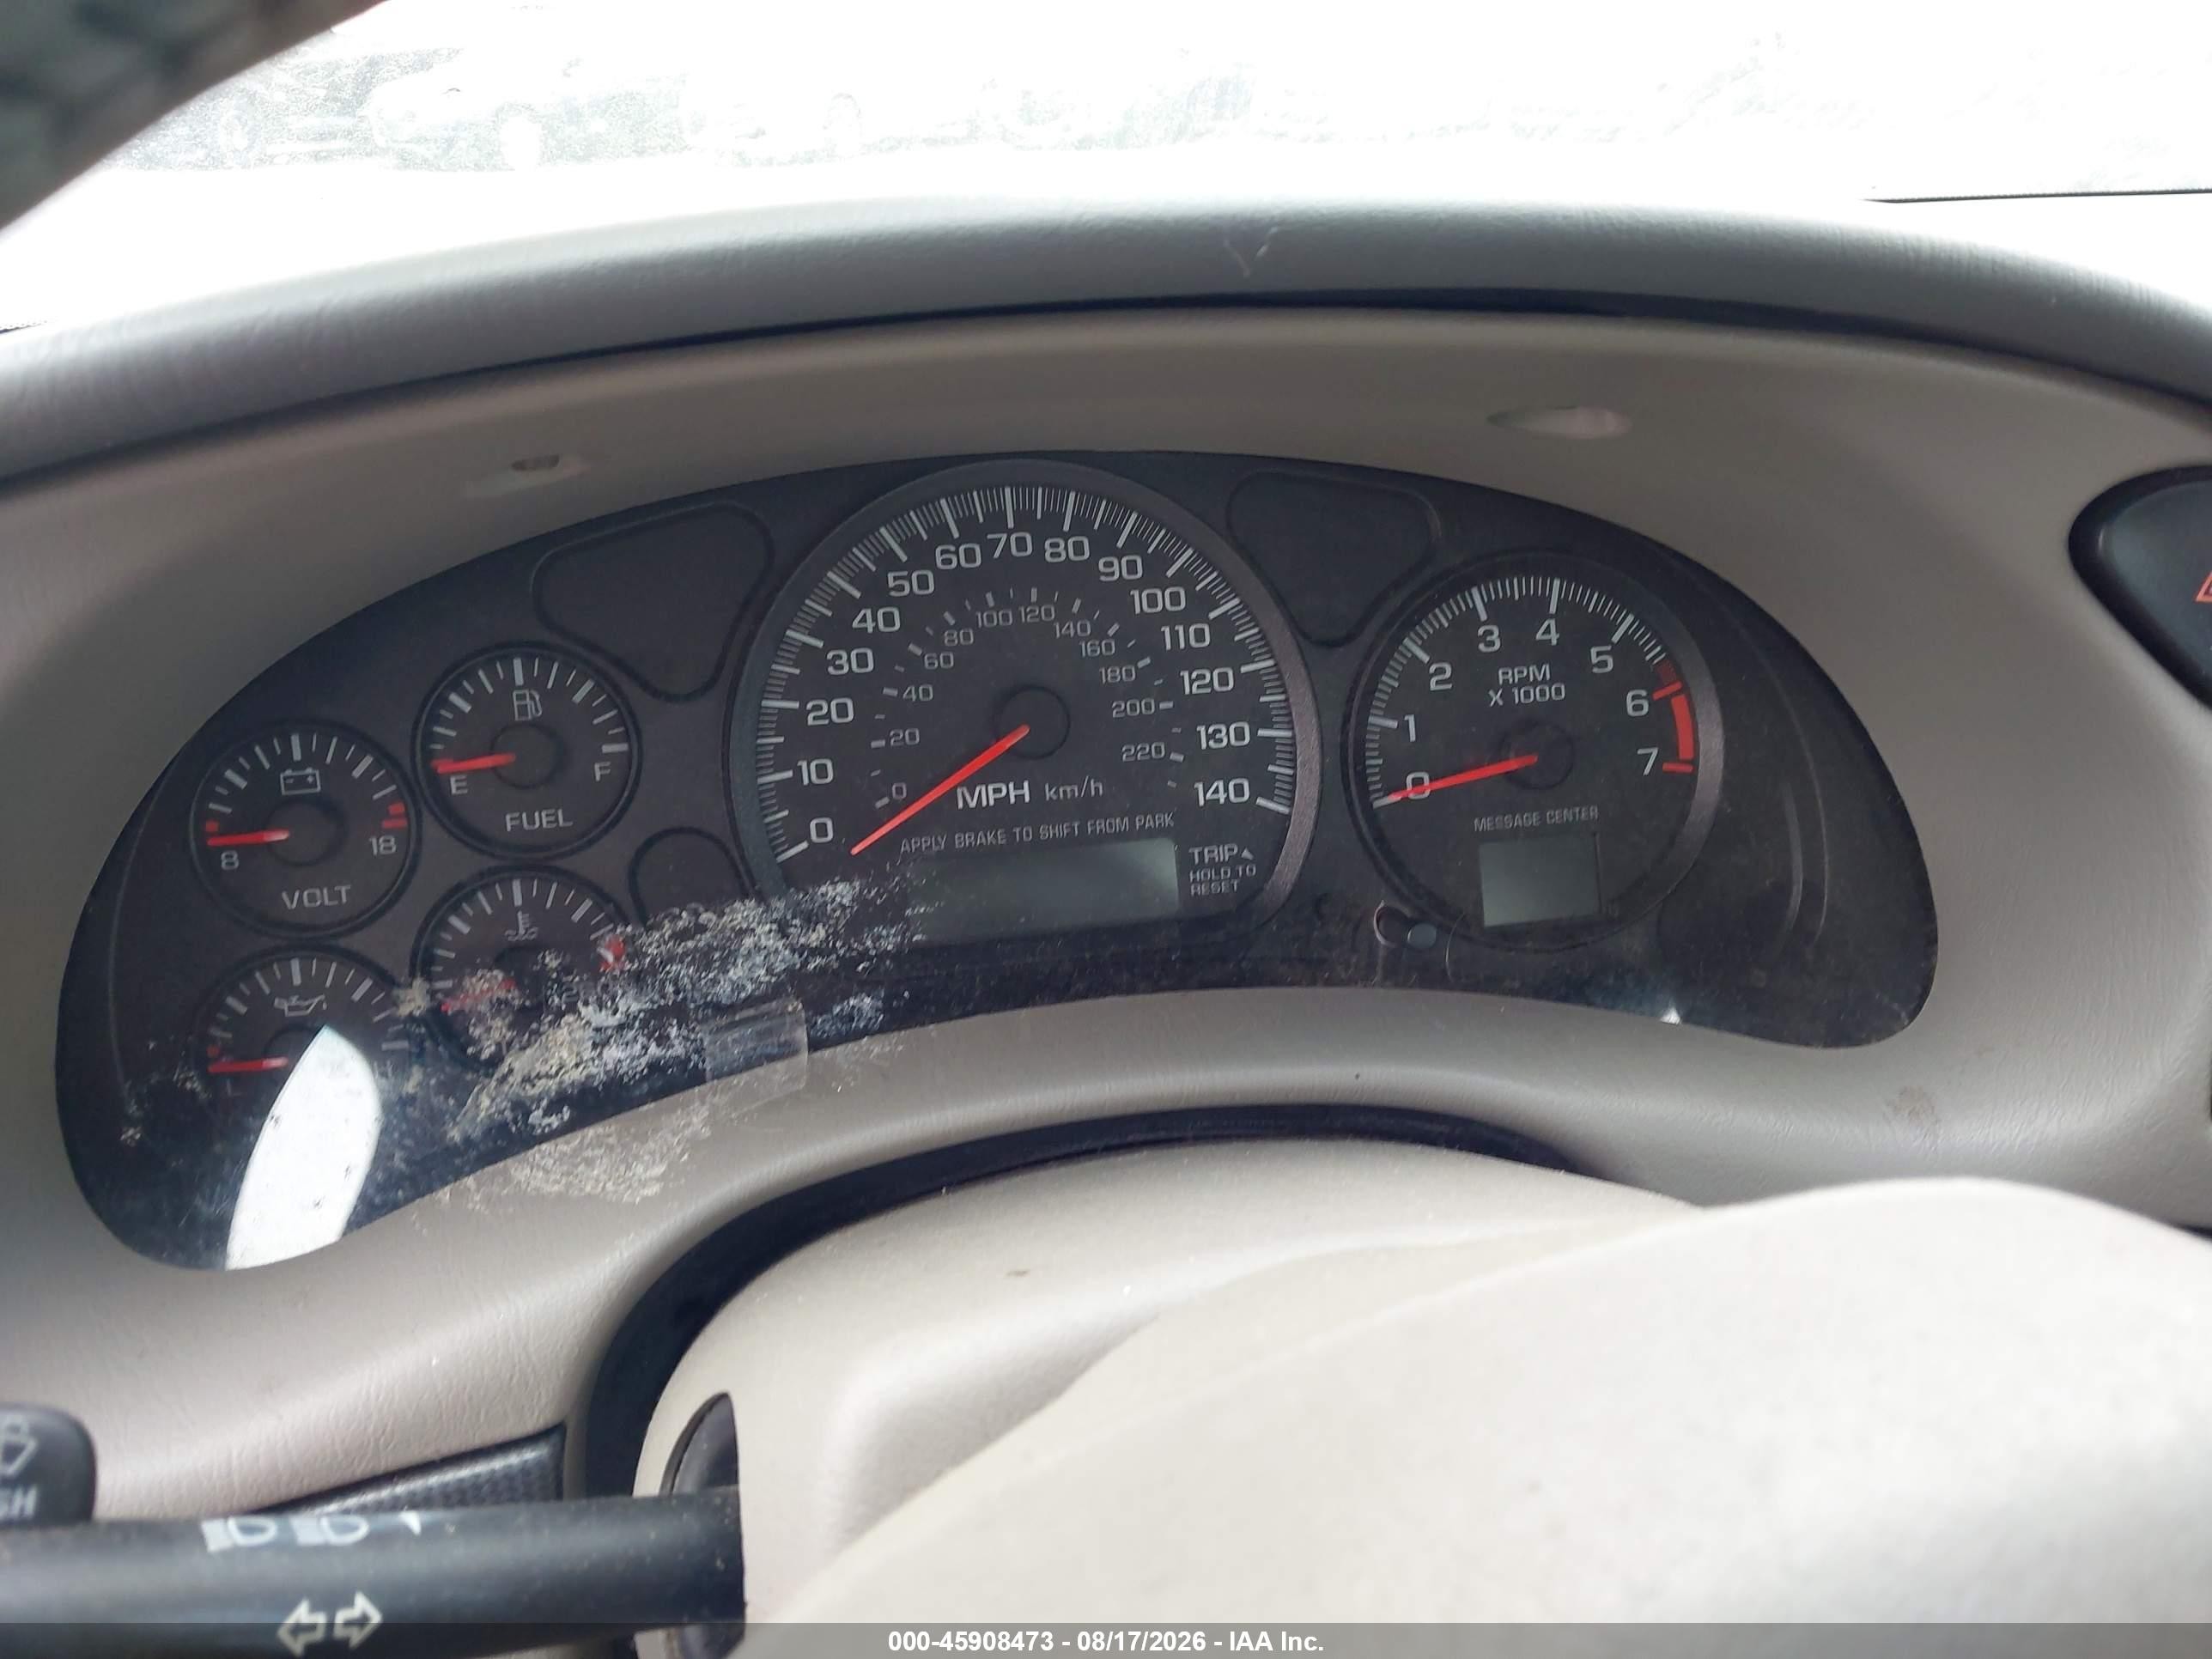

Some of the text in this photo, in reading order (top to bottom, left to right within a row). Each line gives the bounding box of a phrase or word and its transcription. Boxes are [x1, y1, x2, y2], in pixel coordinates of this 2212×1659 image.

[934, 544, 982, 569] 60
[988, 533, 1032, 558] 70
[1044, 536, 1090, 562] 80
[1098, 555, 1143, 580] 90
[887, 570, 935, 596] 50
[1130, 587, 1187, 612] 100
[852, 607, 901, 633] 40
[975, 610, 1013, 628] 100
[1018, 604, 1055, 623] 120
[944, 629, 975, 646] 80
[1054, 619, 1091, 637] 140
[1162, 623, 1211, 649] 110
[1478, 625, 1501, 652] 3
[1535, 618, 1559, 645] 4
[826, 647, 874, 674] 30
[924, 652, 954, 669] 60
[1079, 640, 1115, 657] 160
[1590, 646, 1613, 672] 5
[1099, 666, 1135, 684] 180
[1180, 667, 1234, 694] 120
[1429, 663, 1452, 690] 2
[1498, 664, 1551, 684] RPM
[902, 684, 933, 702] 40
[1488, 684, 1565, 706] X 1000
[1626, 690, 1649, 716] 6
[806, 697, 854, 725] 20
[1112, 698, 1155, 717] 200
[890, 728, 920, 746] 20
[1197, 722, 1250, 748] 130
[1404, 714, 1417, 742] 1
[1121, 743, 1165, 762] 220
[1637, 748, 1659, 775] 7
[593, 763, 611, 781] F
[798, 758, 833, 785] 10
[450, 775, 469, 794] E
[891, 783, 907, 799] 0
[957, 781, 1030, 810] MPH
[1045, 776, 1103, 802] km/h
[1194, 778, 1249, 805] 140
[1405, 772, 1431, 800] 0
[505, 809, 573, 831] FUEL
[810, 817, 833, 842] 0
[1474, 806, 1599, 832] MESSAGE CENTER
[369, 836, 397, 854] 18
[900, 811, 1175, 854] APPLY BRAKE TO SHIFT FROM PARK
[221, 852, 239, 870] 8
[1188, 844, 1238, 865] TRIP
[1189, 864, 1256, 882] HOLD TO
[282, 885, 351, 909] VOLT
[1190, 880, 1240, 895] RESET
